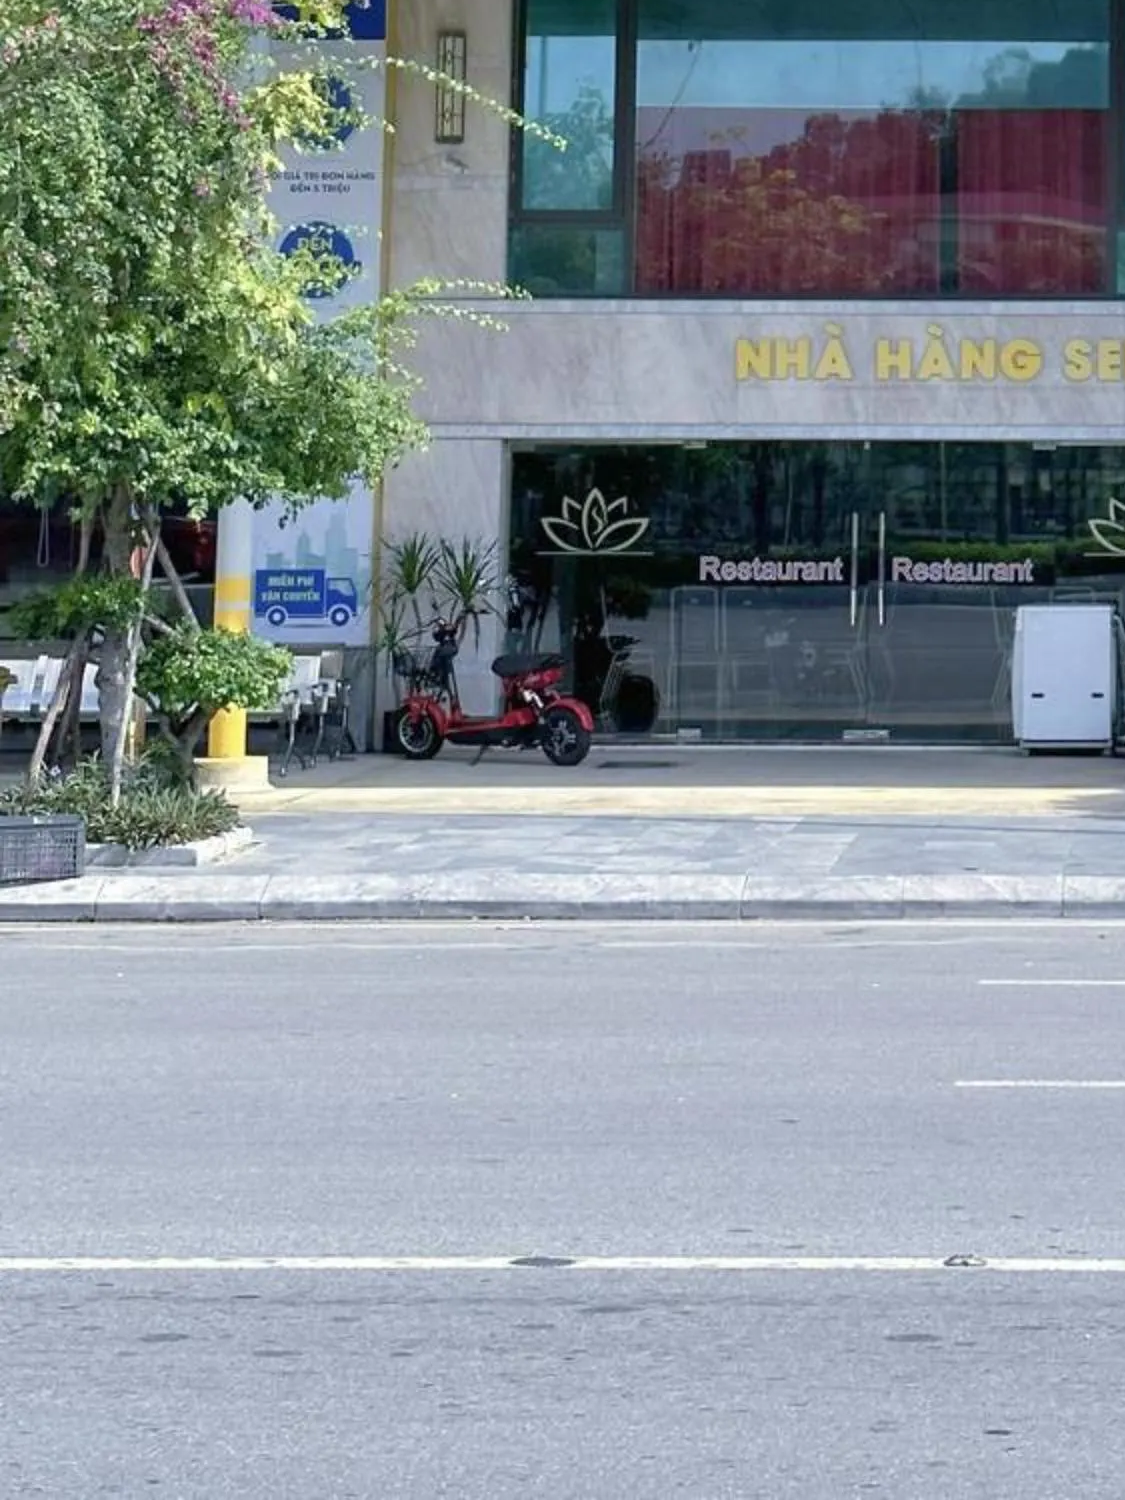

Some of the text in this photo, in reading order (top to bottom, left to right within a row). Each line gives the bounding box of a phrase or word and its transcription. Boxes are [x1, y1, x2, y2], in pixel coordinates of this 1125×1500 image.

[735, 322, 854, 380] NHÀ
[876, 323, 1042, 380] HÀNG
[700, 555, 844, 582] Restaurant
[891, 556, 1034, 582] Restaurant
